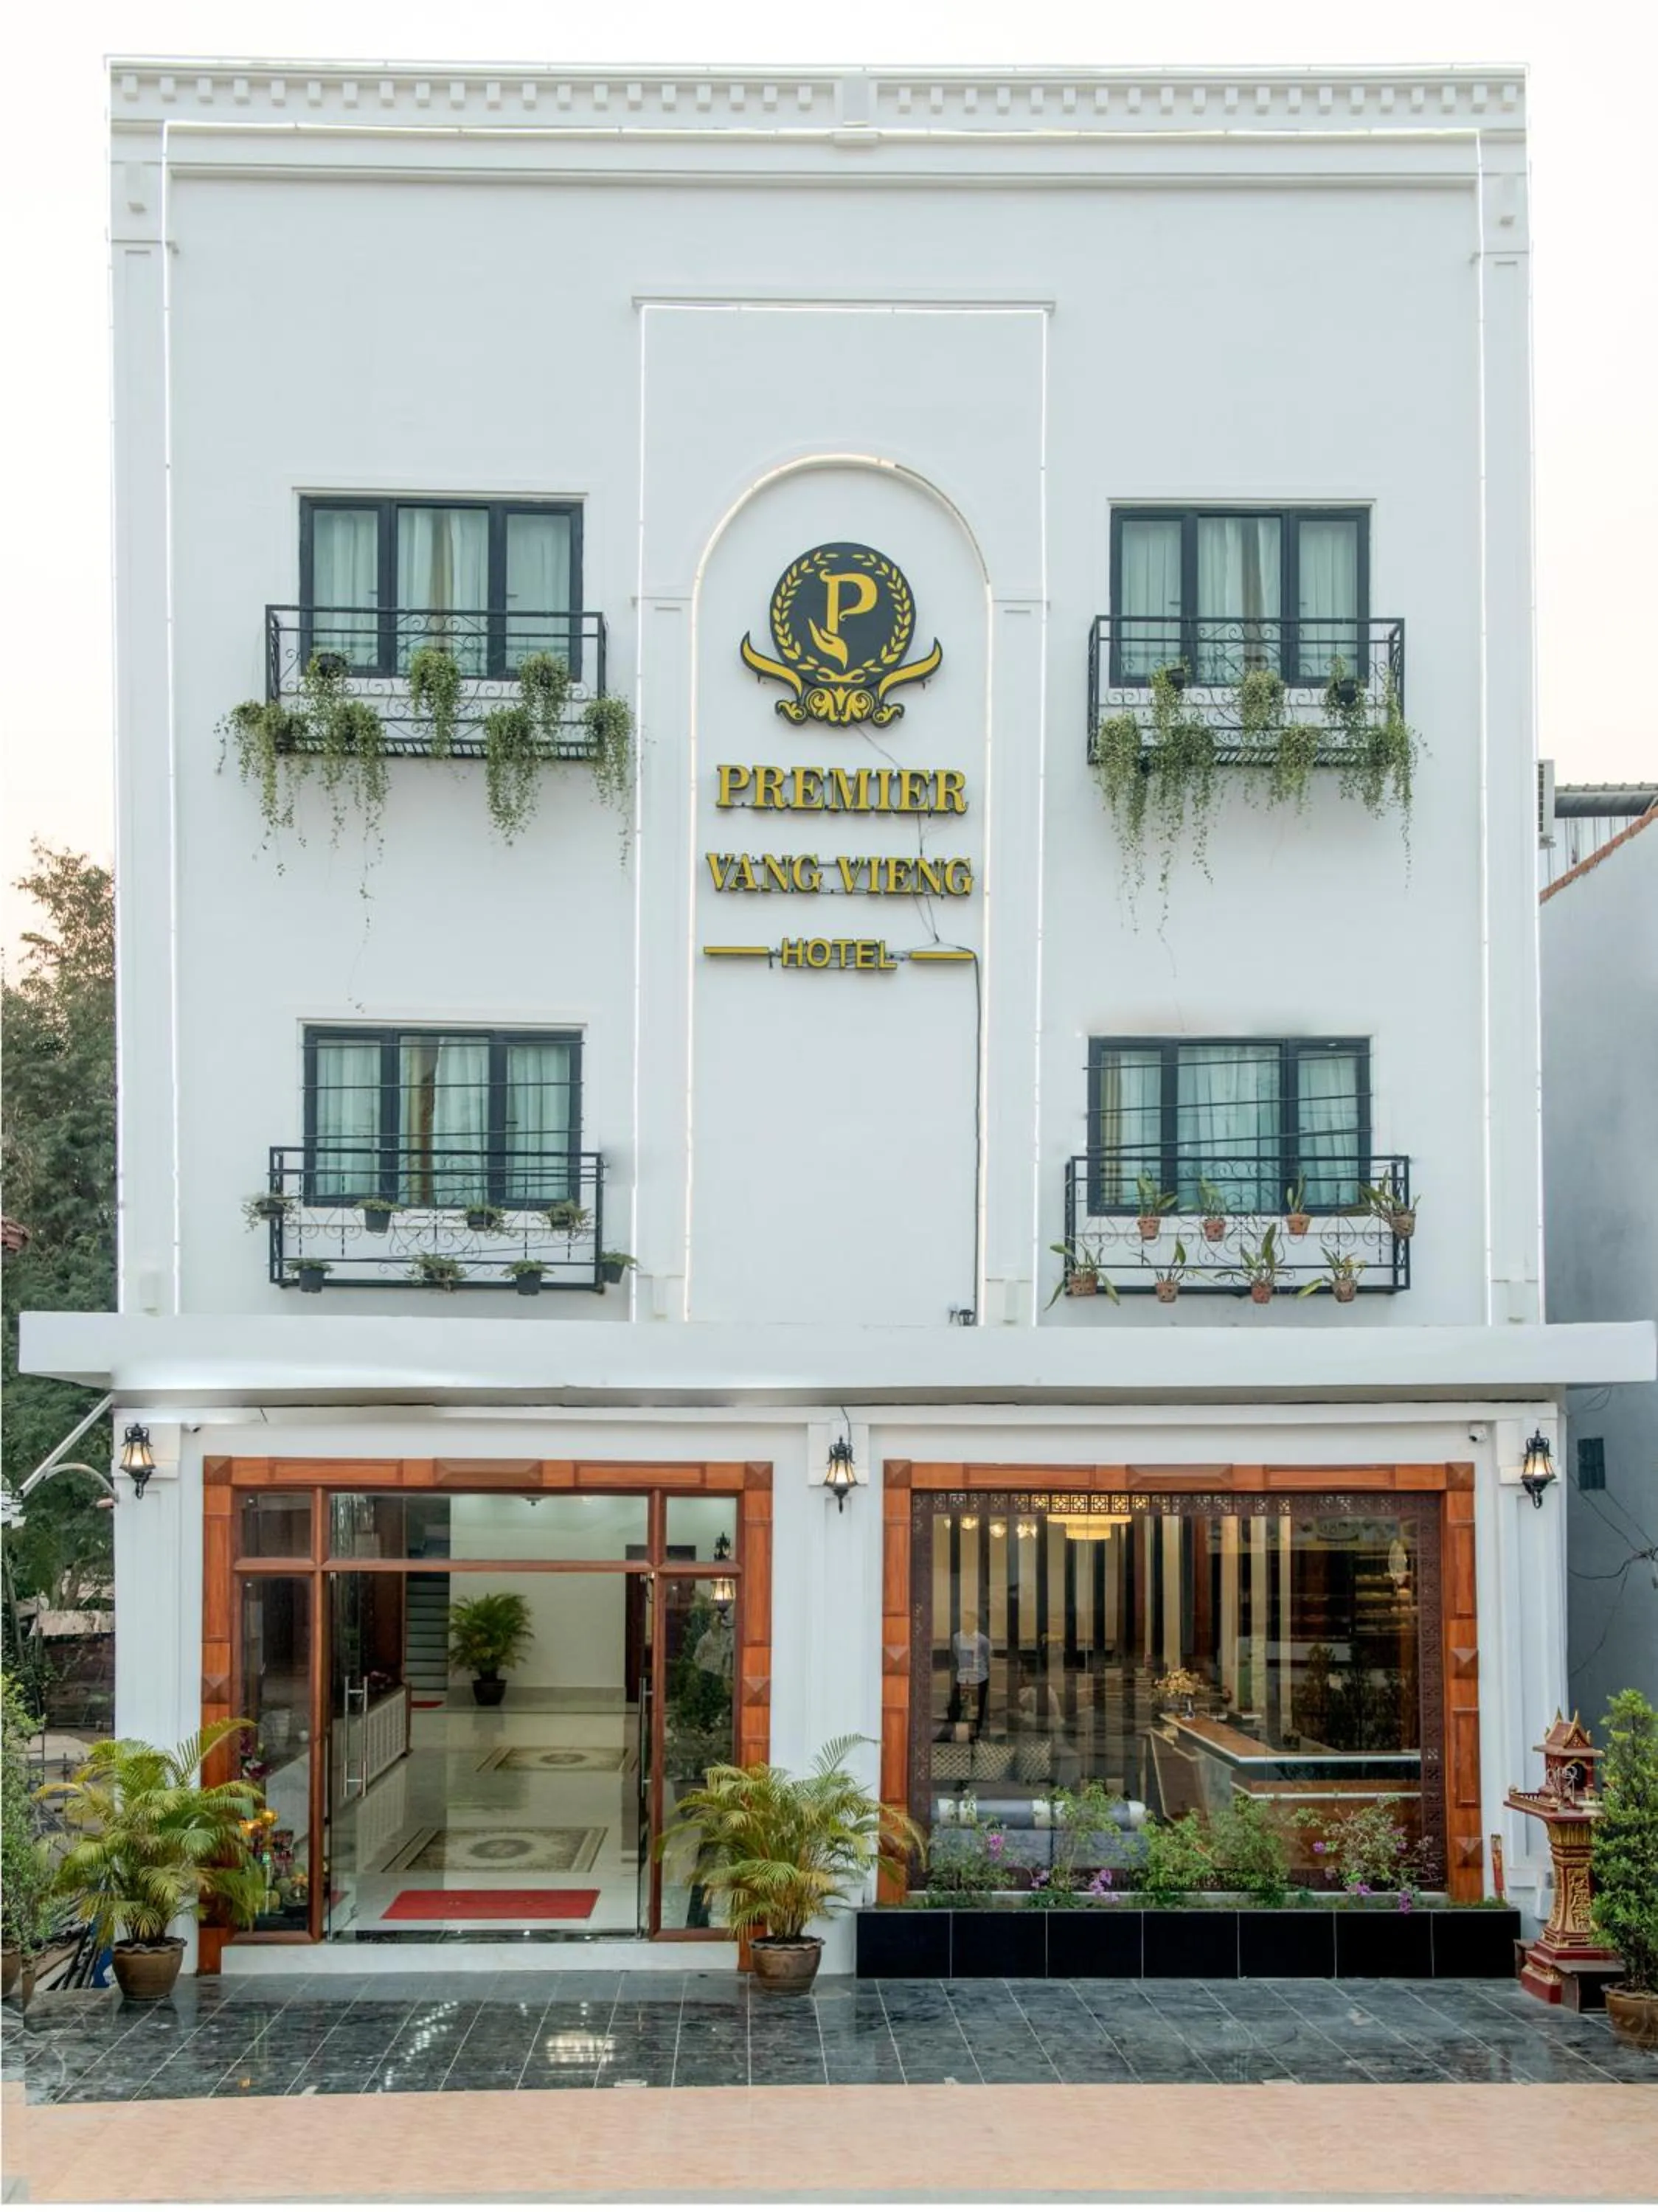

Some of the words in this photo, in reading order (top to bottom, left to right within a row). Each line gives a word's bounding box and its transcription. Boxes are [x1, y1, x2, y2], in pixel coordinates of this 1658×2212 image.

[819, 569, 878, 636] P
[716, 765, 968, 814] PREMIER
[706, 852, 822, 893] VANG
[836, 856, 974, 897] VIENG
[781, 937, 898, 970] HOTEL
